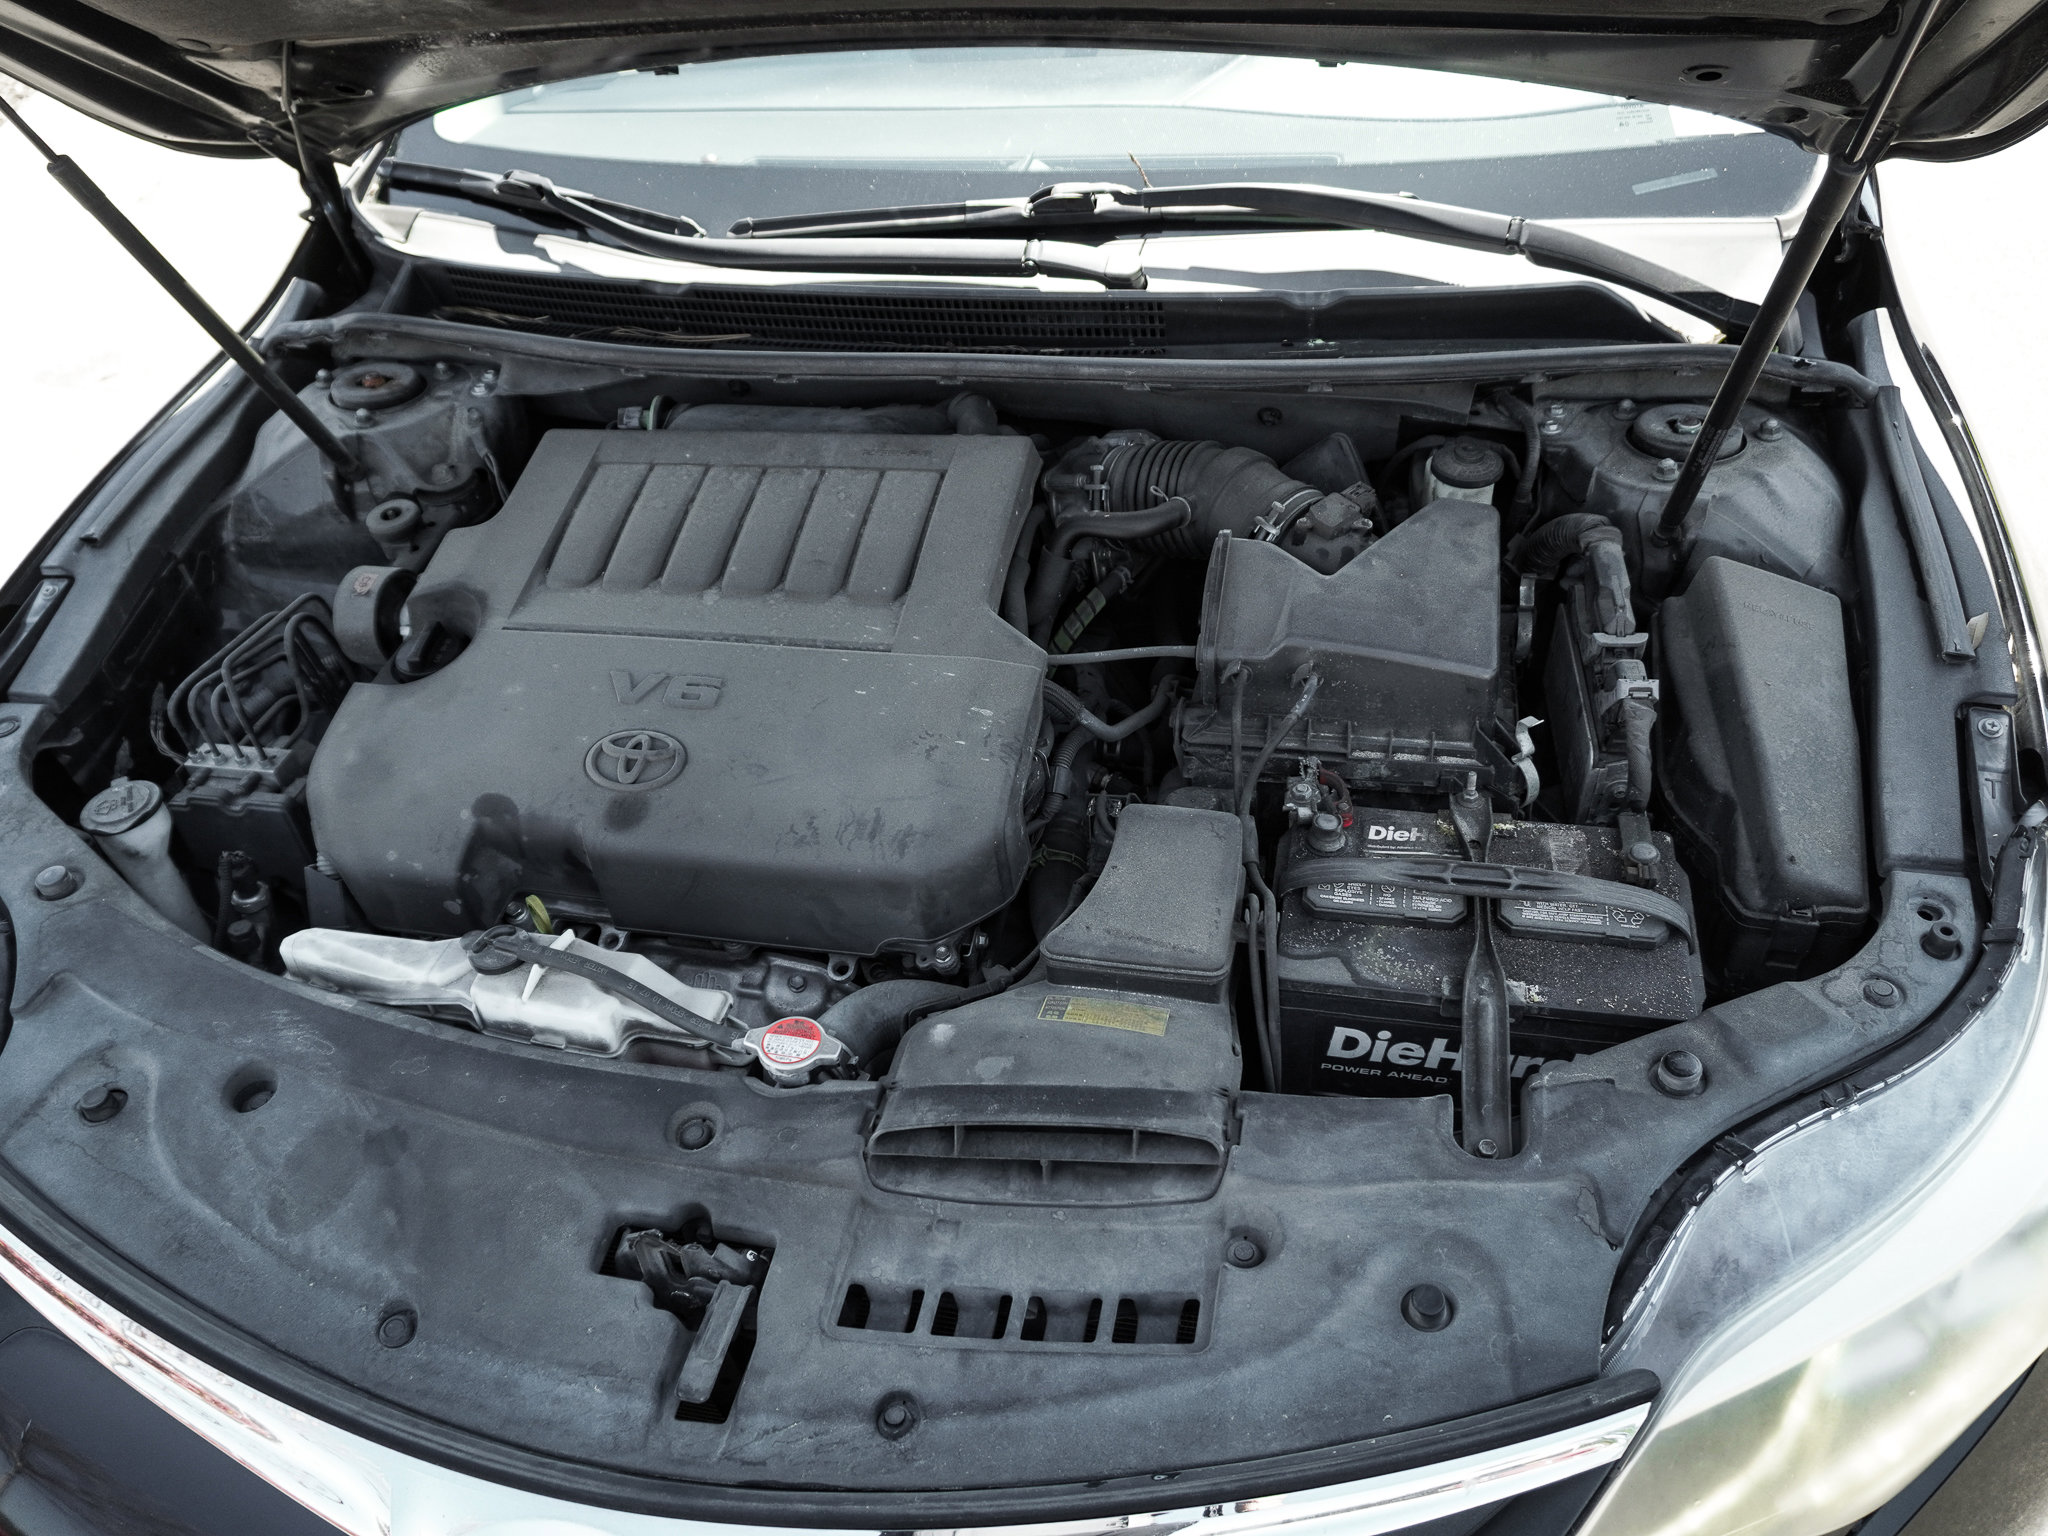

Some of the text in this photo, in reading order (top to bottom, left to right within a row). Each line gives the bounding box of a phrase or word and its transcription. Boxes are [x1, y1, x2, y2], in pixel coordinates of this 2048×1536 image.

[609, 670, 726, 709] V6
[1368, 825, 1436, 842] DieH
[1327, 1026, 1572, 1079] DieHr
[1321, 1063, 1448, 1083] POWER AHEAD
